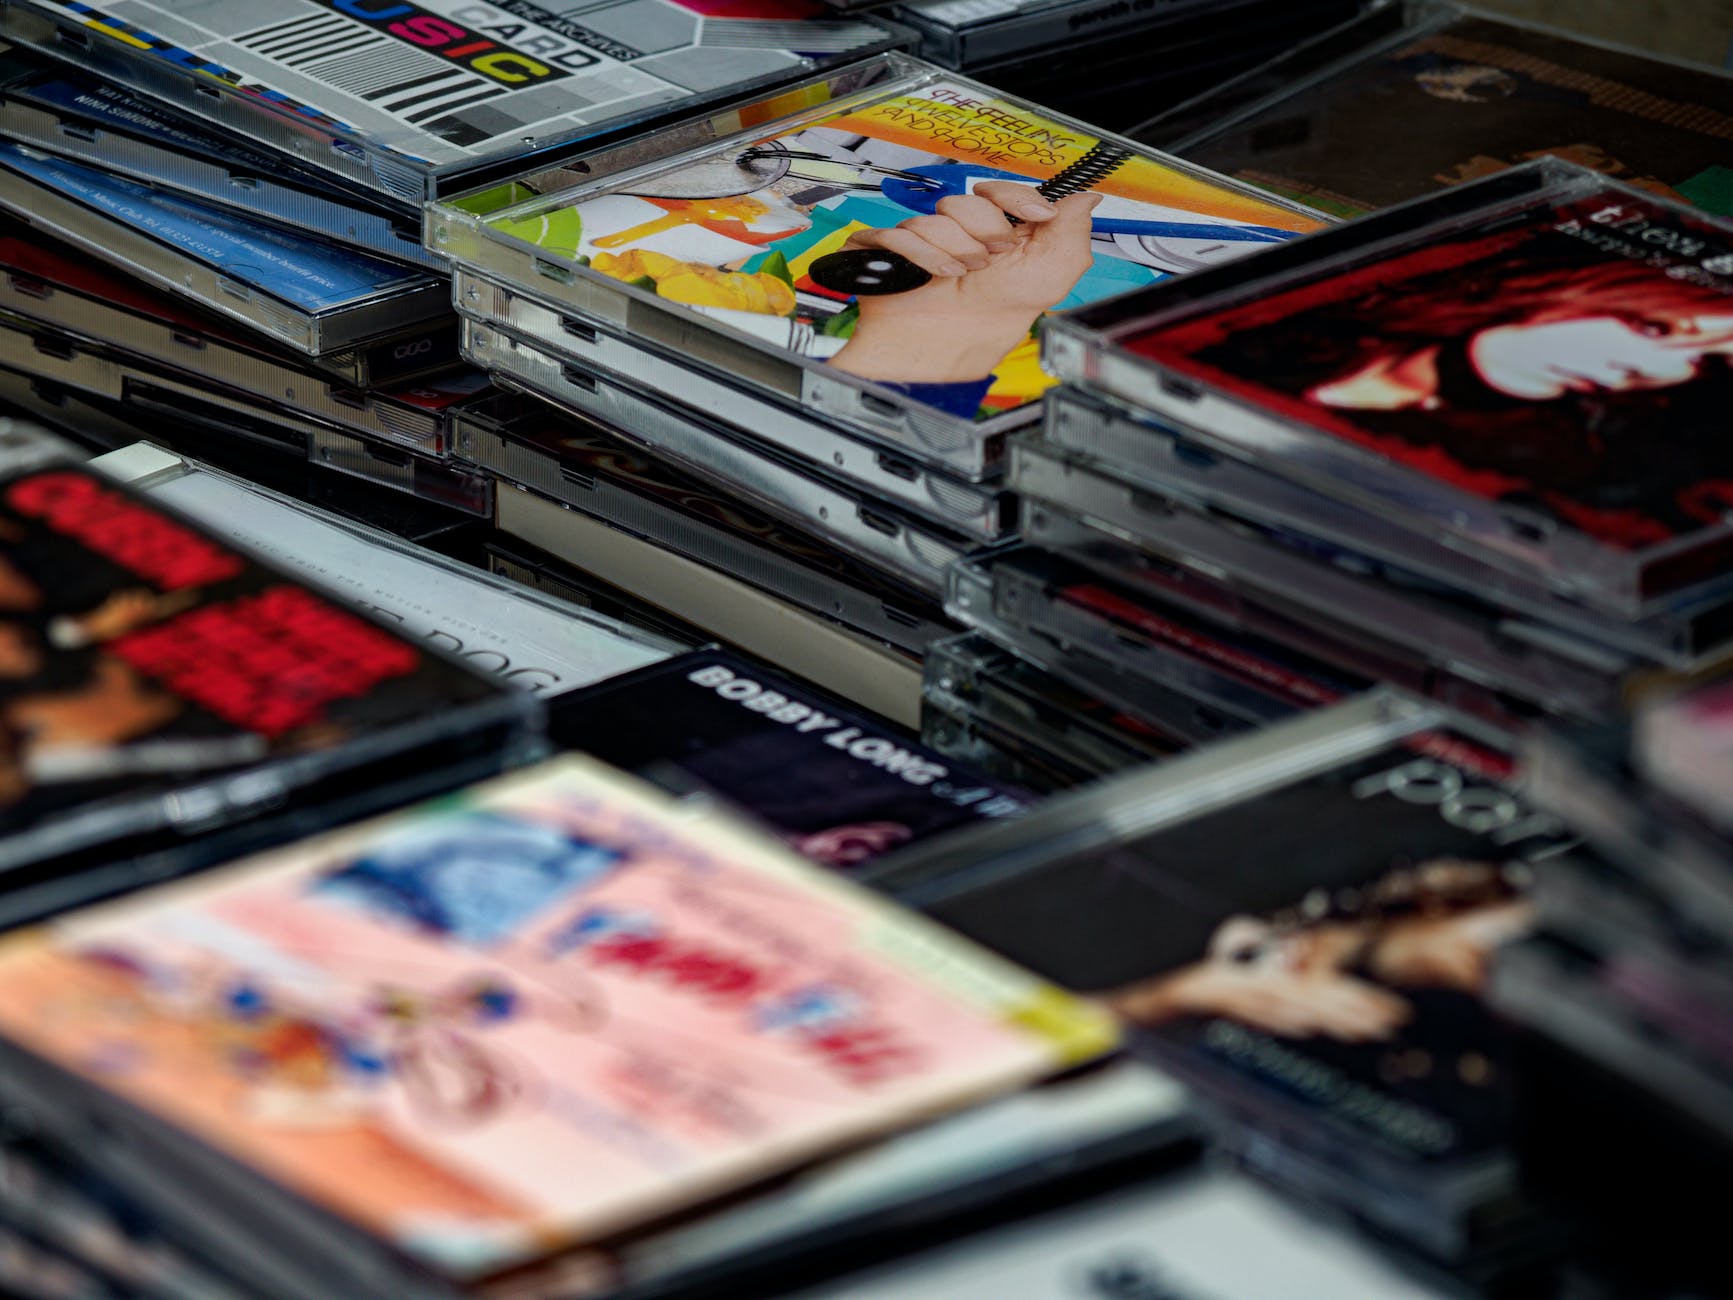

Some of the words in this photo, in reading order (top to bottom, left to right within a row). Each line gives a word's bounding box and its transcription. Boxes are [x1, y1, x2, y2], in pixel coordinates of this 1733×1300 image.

[449, 5, 602, 69] CARD
[509, 3, 550, 22] THE
[541, 19, 639, 60] ARCHIVES
[75, 94, 109, 111] NINA
[107, 107, 160, 130] SIMONE
[873, 107, 935, 131] AND
[930, 127, 1017, 165] HOME
[902, 98, 989, 138] TWELVE
[981, 132, 1065, 166] STOPS
[932, 89, 981, 112] THE
[975, 106, 1076, 150] FEELING
[118, 206, 144, 221] Club
[211, 228, 247, 245] special
[241, 242, 280, 262] member
[278, 259, 314, 278] benefit
[287, 555, 328, 574] FROM
[336, 574, 365, 588] THE
[688, 664, 843, 733] BOBBY
[822, 728, 948, 786] LONG
